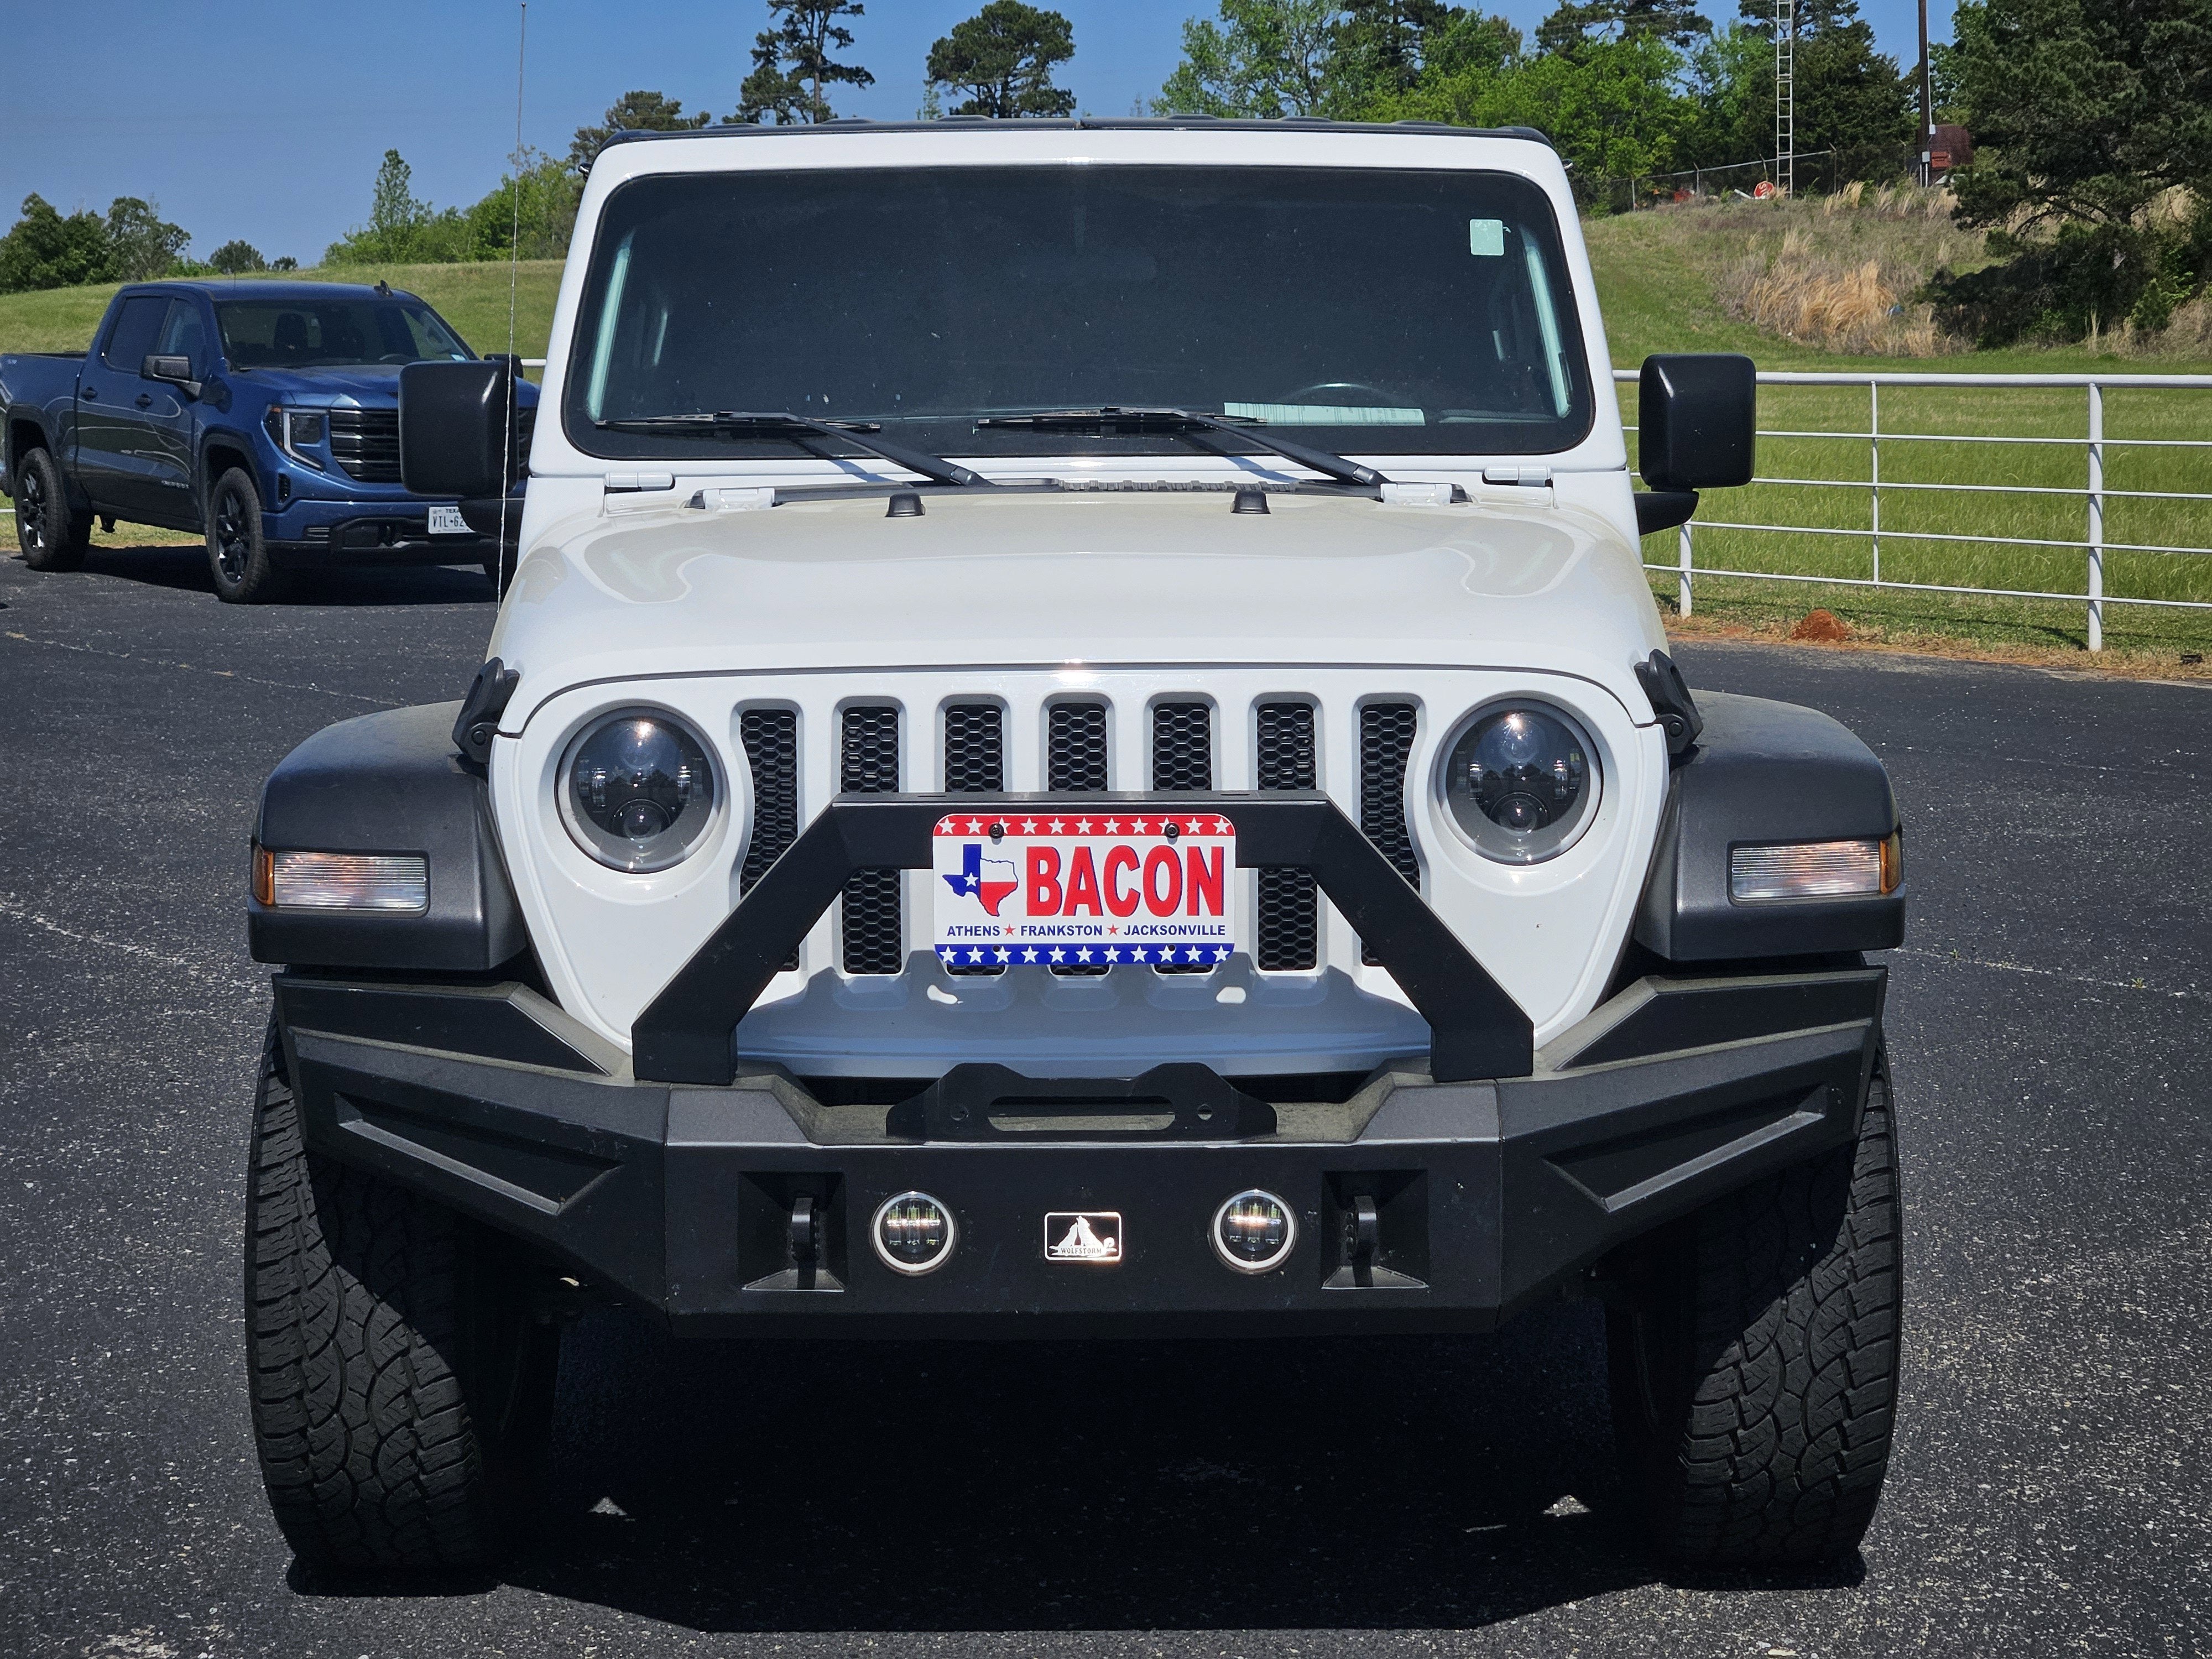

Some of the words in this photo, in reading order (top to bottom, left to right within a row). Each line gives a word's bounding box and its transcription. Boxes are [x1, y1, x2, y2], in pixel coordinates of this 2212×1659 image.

[1026, 845, 1224, 917] BACON
[947, 925, 1000, 936] ATHENS
[1021, 925, 1102, 936] FRANKSTON
[1124, 925, 1225, 936] JACKSONVILLE
